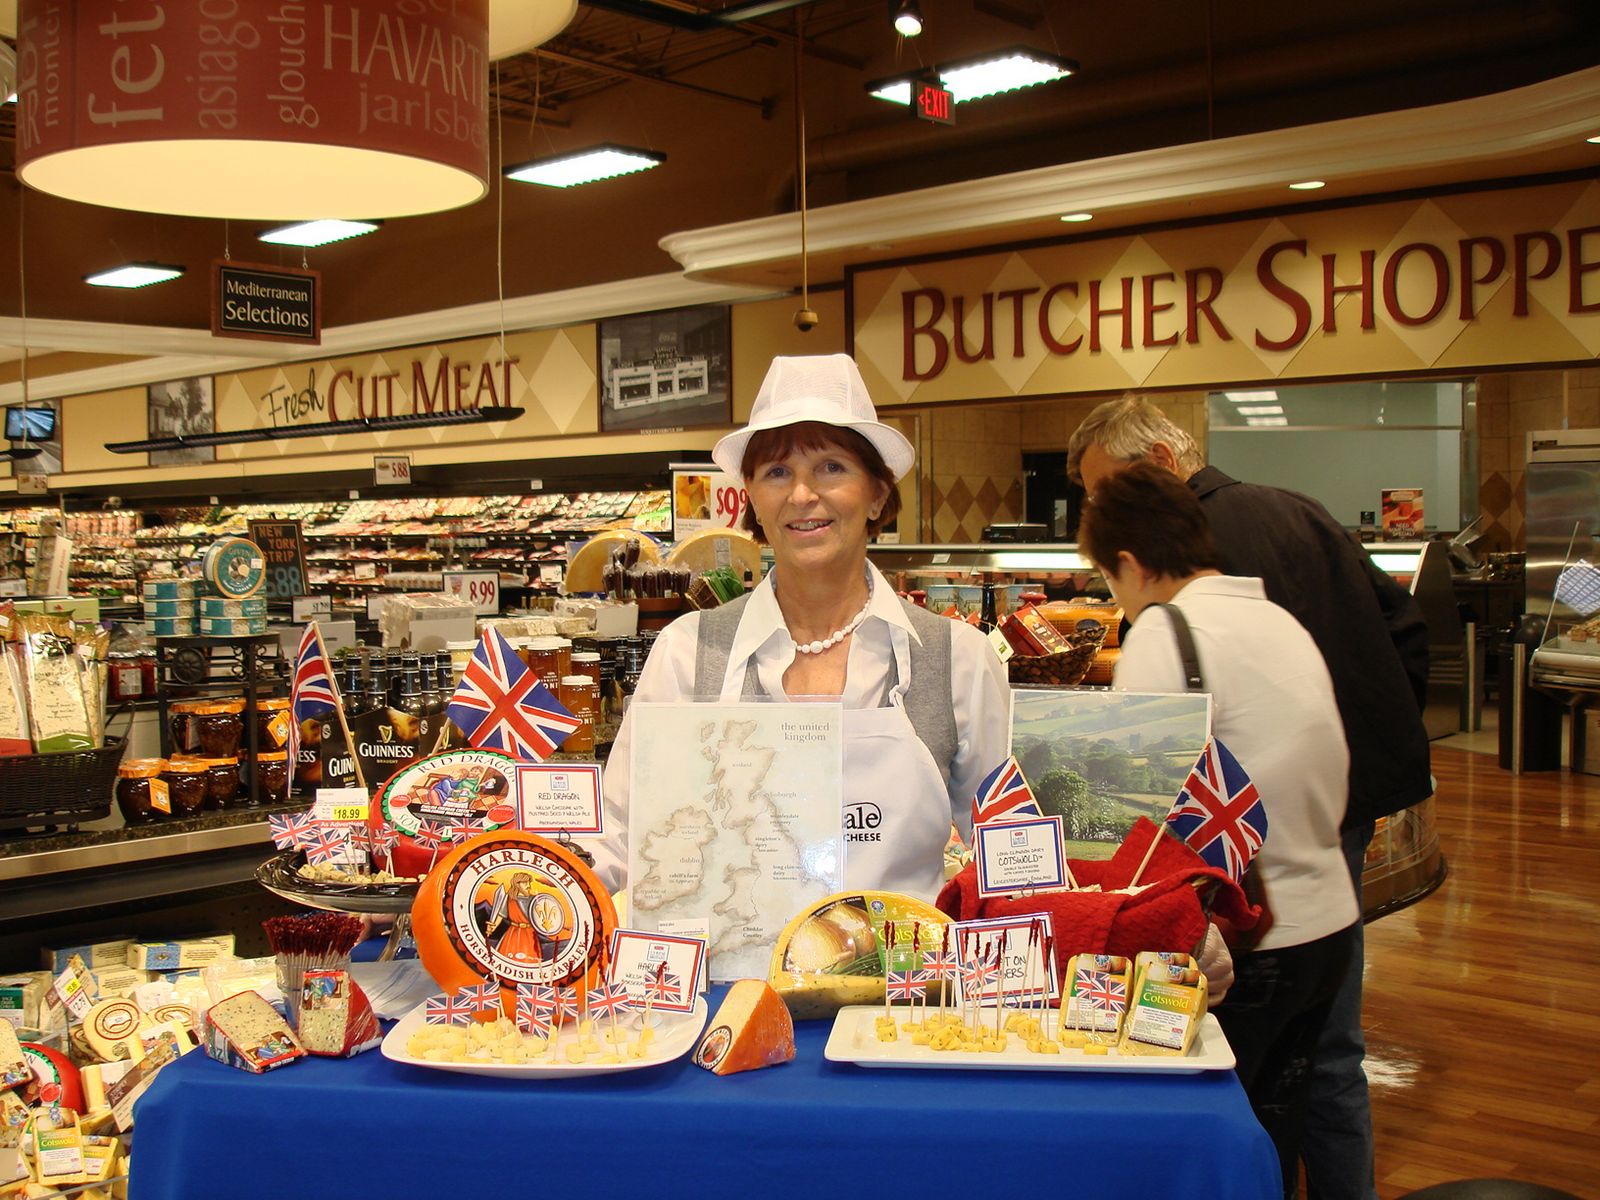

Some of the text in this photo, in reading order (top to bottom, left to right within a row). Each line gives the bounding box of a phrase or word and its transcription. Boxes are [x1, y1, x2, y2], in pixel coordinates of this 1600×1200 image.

[88, 0, 166, 128] fet
[266, 0, 320, 128] glouch
[925, 87, 949, 119] EXIT
[226, 280, 308, 302] Mediterranean
[225, 300, 310, 328] Selections
[901, 225, 1600, 382] BUTCHER SHOPPE
[261, 357, 520, 427] Fresh CUT MEAT
[259, 526, 282, 537] NEW
[268, 538, 296, 550] YORK
[781, 722, 830, 731] the united
[784, 732, 826, 743] kingdom
[359, 742, 416, 758] GUINNESS
[328, 758, 355, 777] GUIN
[418, 755, 516, 783] RED DRAGO
[538, 792, 580, 801] RED DRAGON
[843, 833, 881, 842] CHEESE
[470, 850, 576, 889] HARLECH
[459, 923, 534, 980] HORSERADISH
[551, 941, 587, 977] PARSLEY
[1143, 992, 1189, 1009] Cotswold
